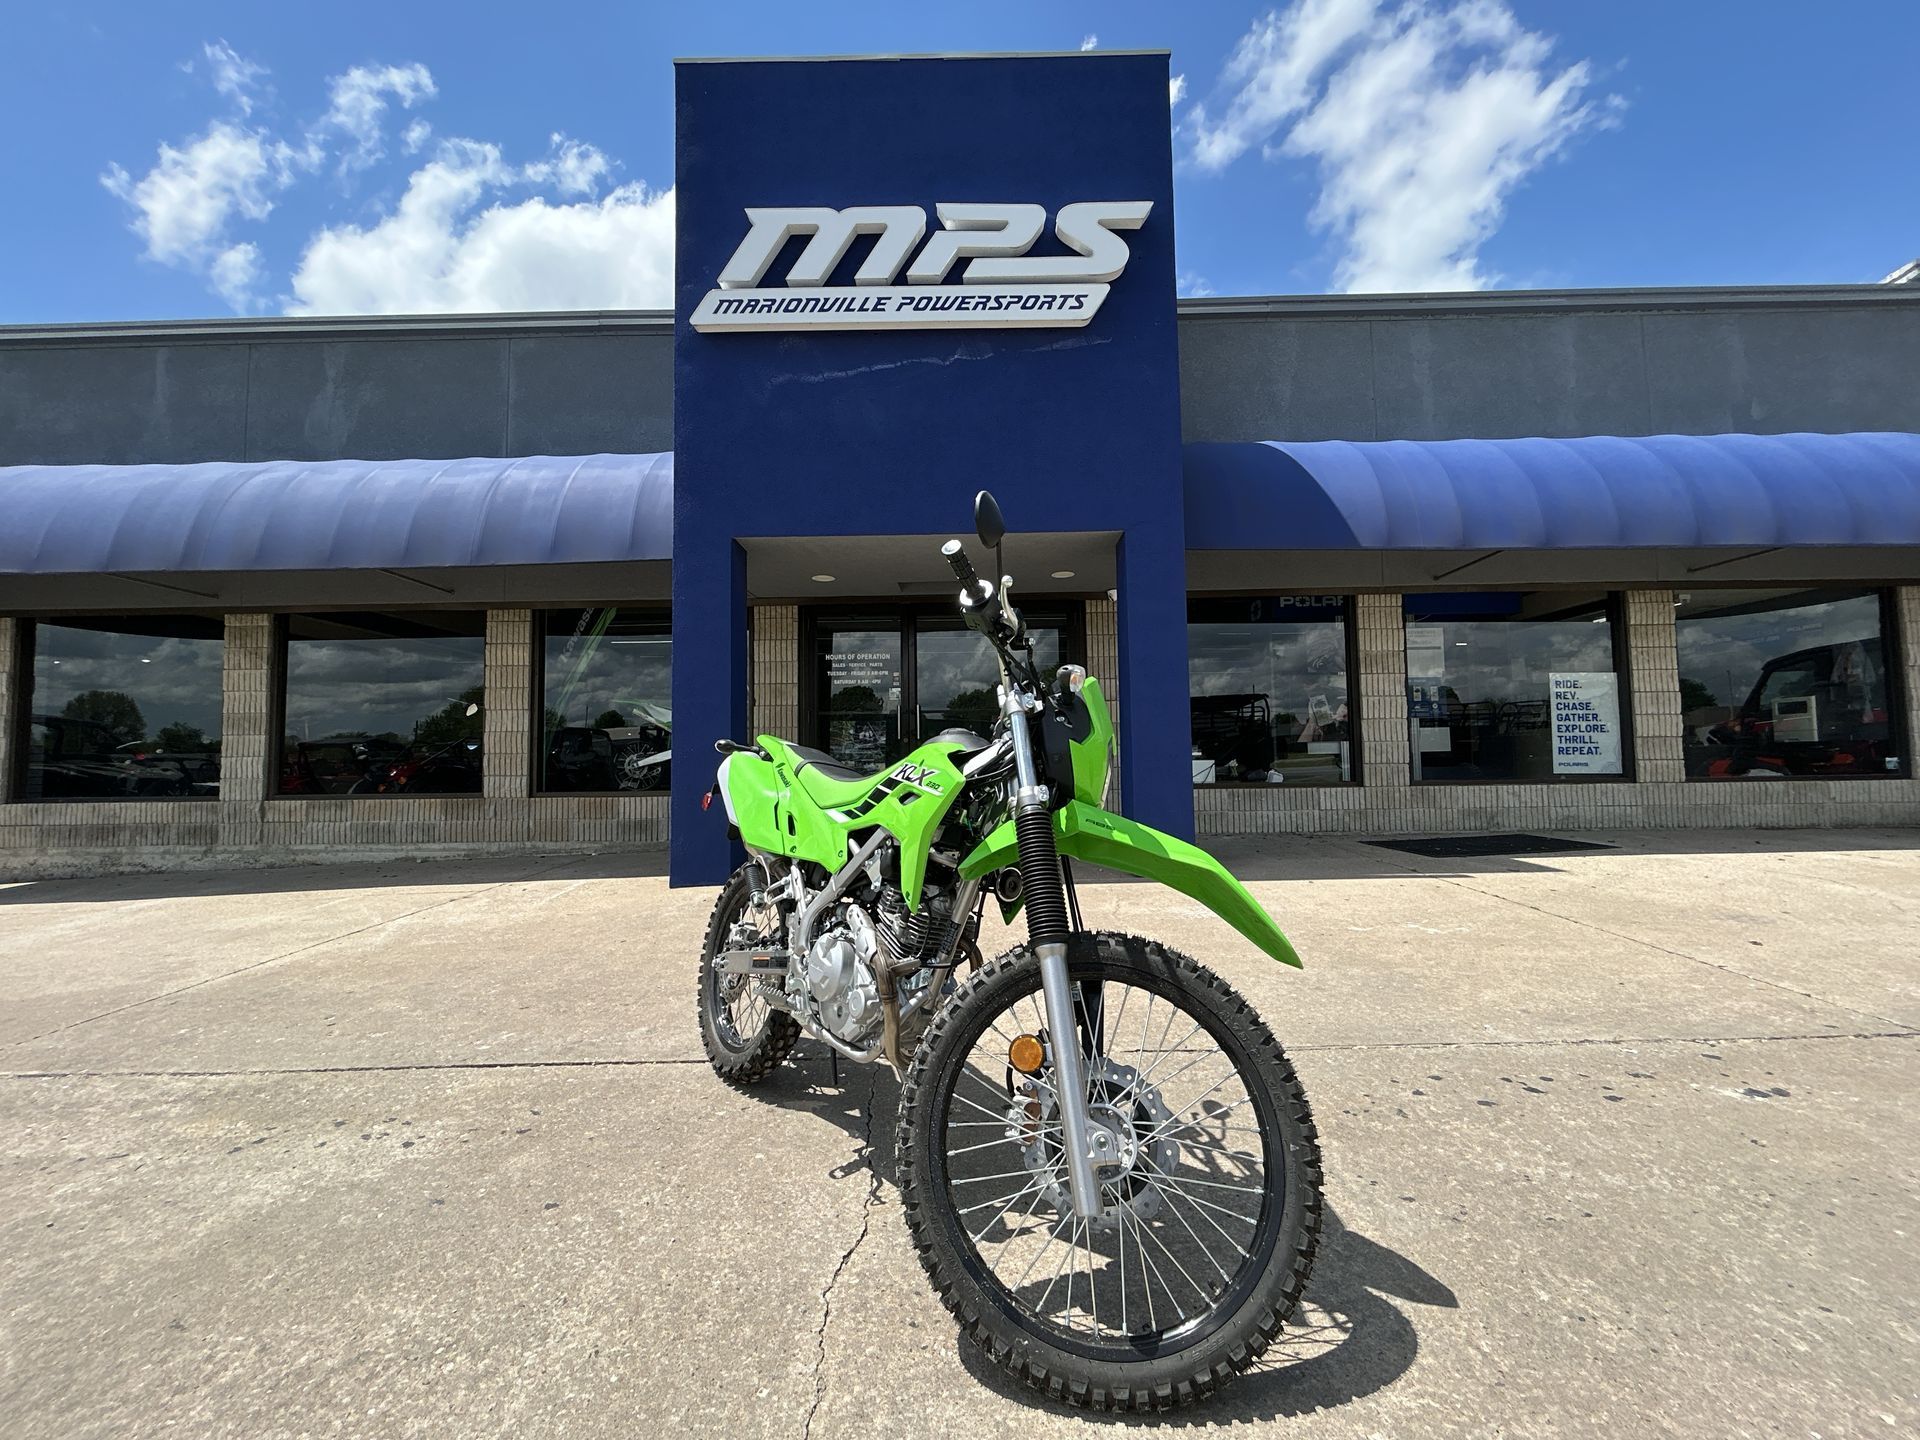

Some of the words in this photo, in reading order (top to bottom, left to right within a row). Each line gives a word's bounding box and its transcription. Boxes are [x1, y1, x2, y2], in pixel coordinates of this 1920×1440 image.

[717, 201, 1154, 290] MPS
[711, 295, 893, 315] MARIONVILLE
[895, 293, 1088, 313] POWERSPORTS
[1555, 680, 1582, 689] RIDE.
[1555, 691, 1580, 700] REV.
[1556, 702, 1595, 711] CHASE.
[1556, 713, 1602, 722] GATHER.
[1557, 724, 1610, 733] EXPLORE.
[1557, 735, 1599, 744] THRILL.
[1558, 746, 1602, 755] REPEAT.
[894, 763, 936, 787] KLX
